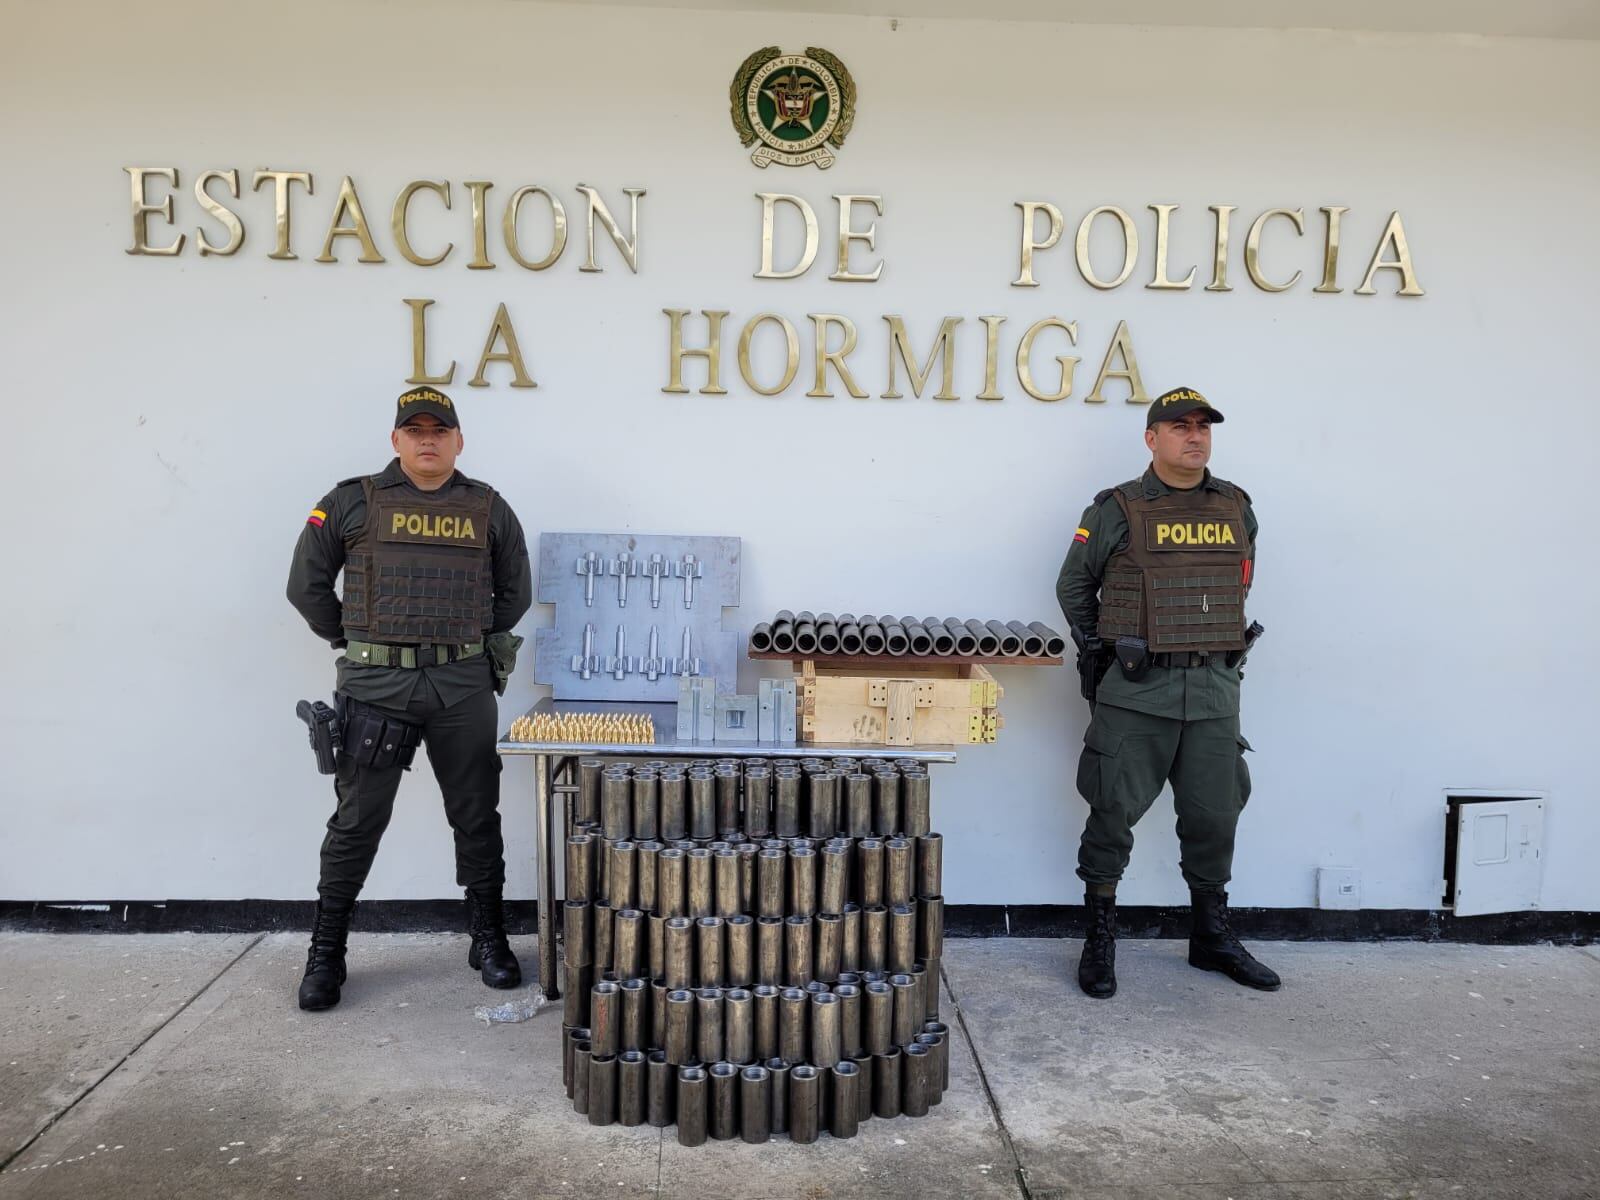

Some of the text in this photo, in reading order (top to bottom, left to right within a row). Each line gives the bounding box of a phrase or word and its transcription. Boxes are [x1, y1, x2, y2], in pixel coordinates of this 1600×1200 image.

[748, 57, 838, 106] REPUBLICA DE COLOMBIA
[755, 118, 837, 149] POLICIA NACIONAL
[759, 148, 782, 160] DIOS
[794, 148, 828, 163] PATRIA
[123, 166, 1425, 296] ESTACION DE POLICIA
[402, 298, 1151, 404] LA HORMIGA
[399, 391, 451, 409] POLICIA
[391, 513, 476, 540] POLICIA
[1156, 523, 1236, 545] POLICIA
